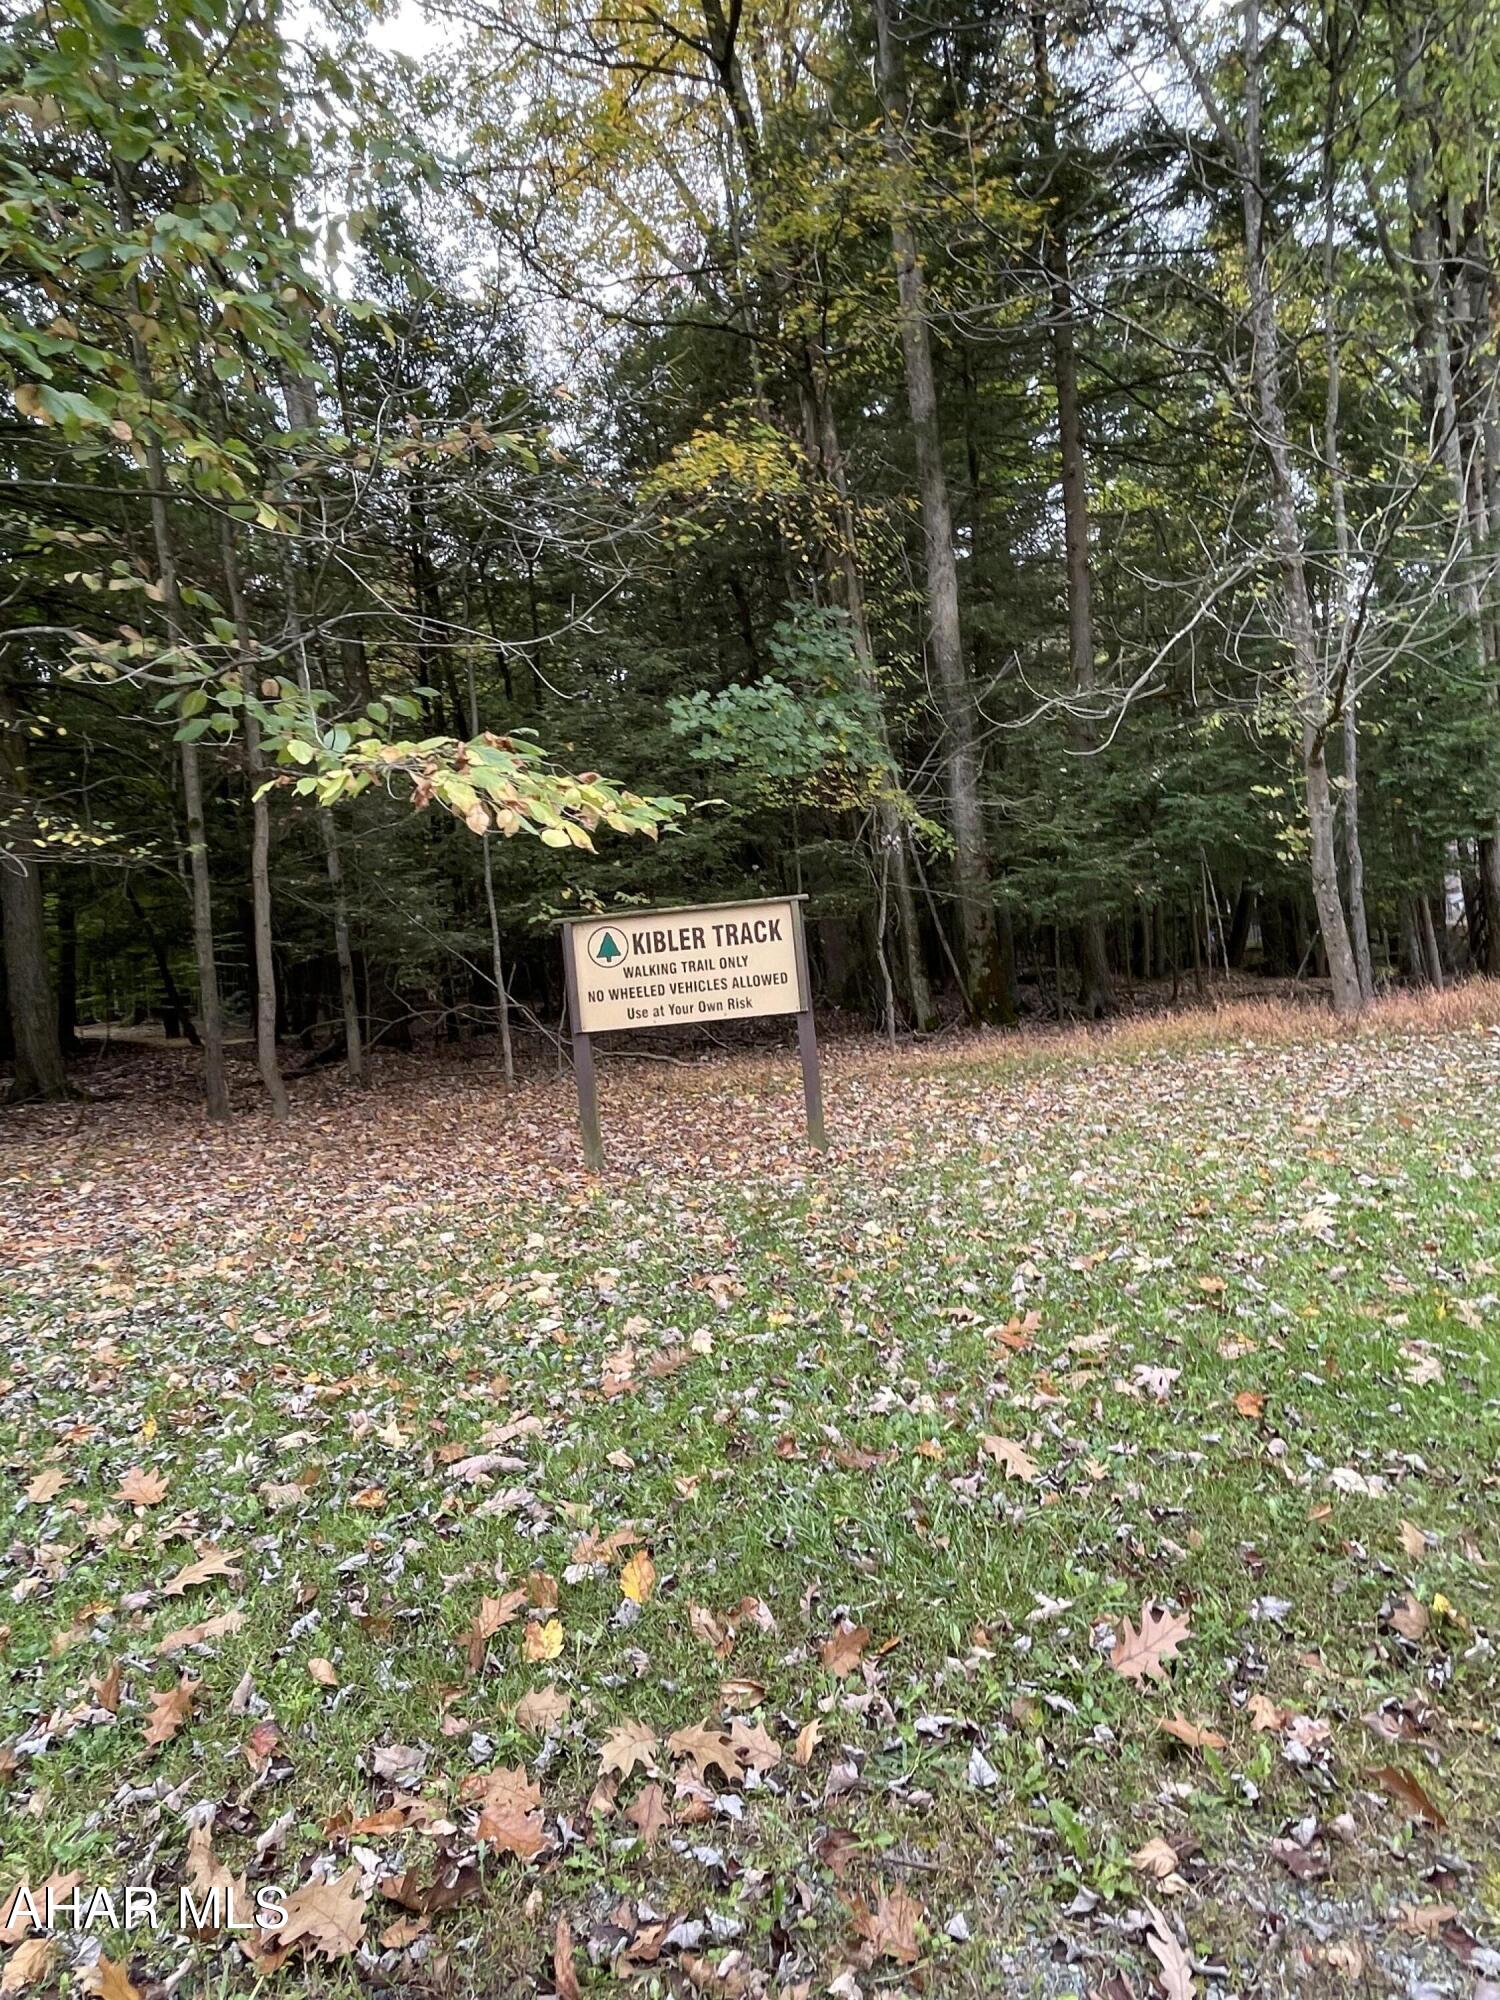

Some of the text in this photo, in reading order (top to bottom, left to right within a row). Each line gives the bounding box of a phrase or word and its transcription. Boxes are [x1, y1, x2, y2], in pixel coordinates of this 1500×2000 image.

[632, 918, 782, 955] KIBLER TRACK
[623, 955, 749, 979] WALKING TRAIL ONLY
[588, 971, 788, 1003] NO WHEELED VEHICLES ALLOWED
[627, 996, 753, 1020] Use at Your Own Risk
